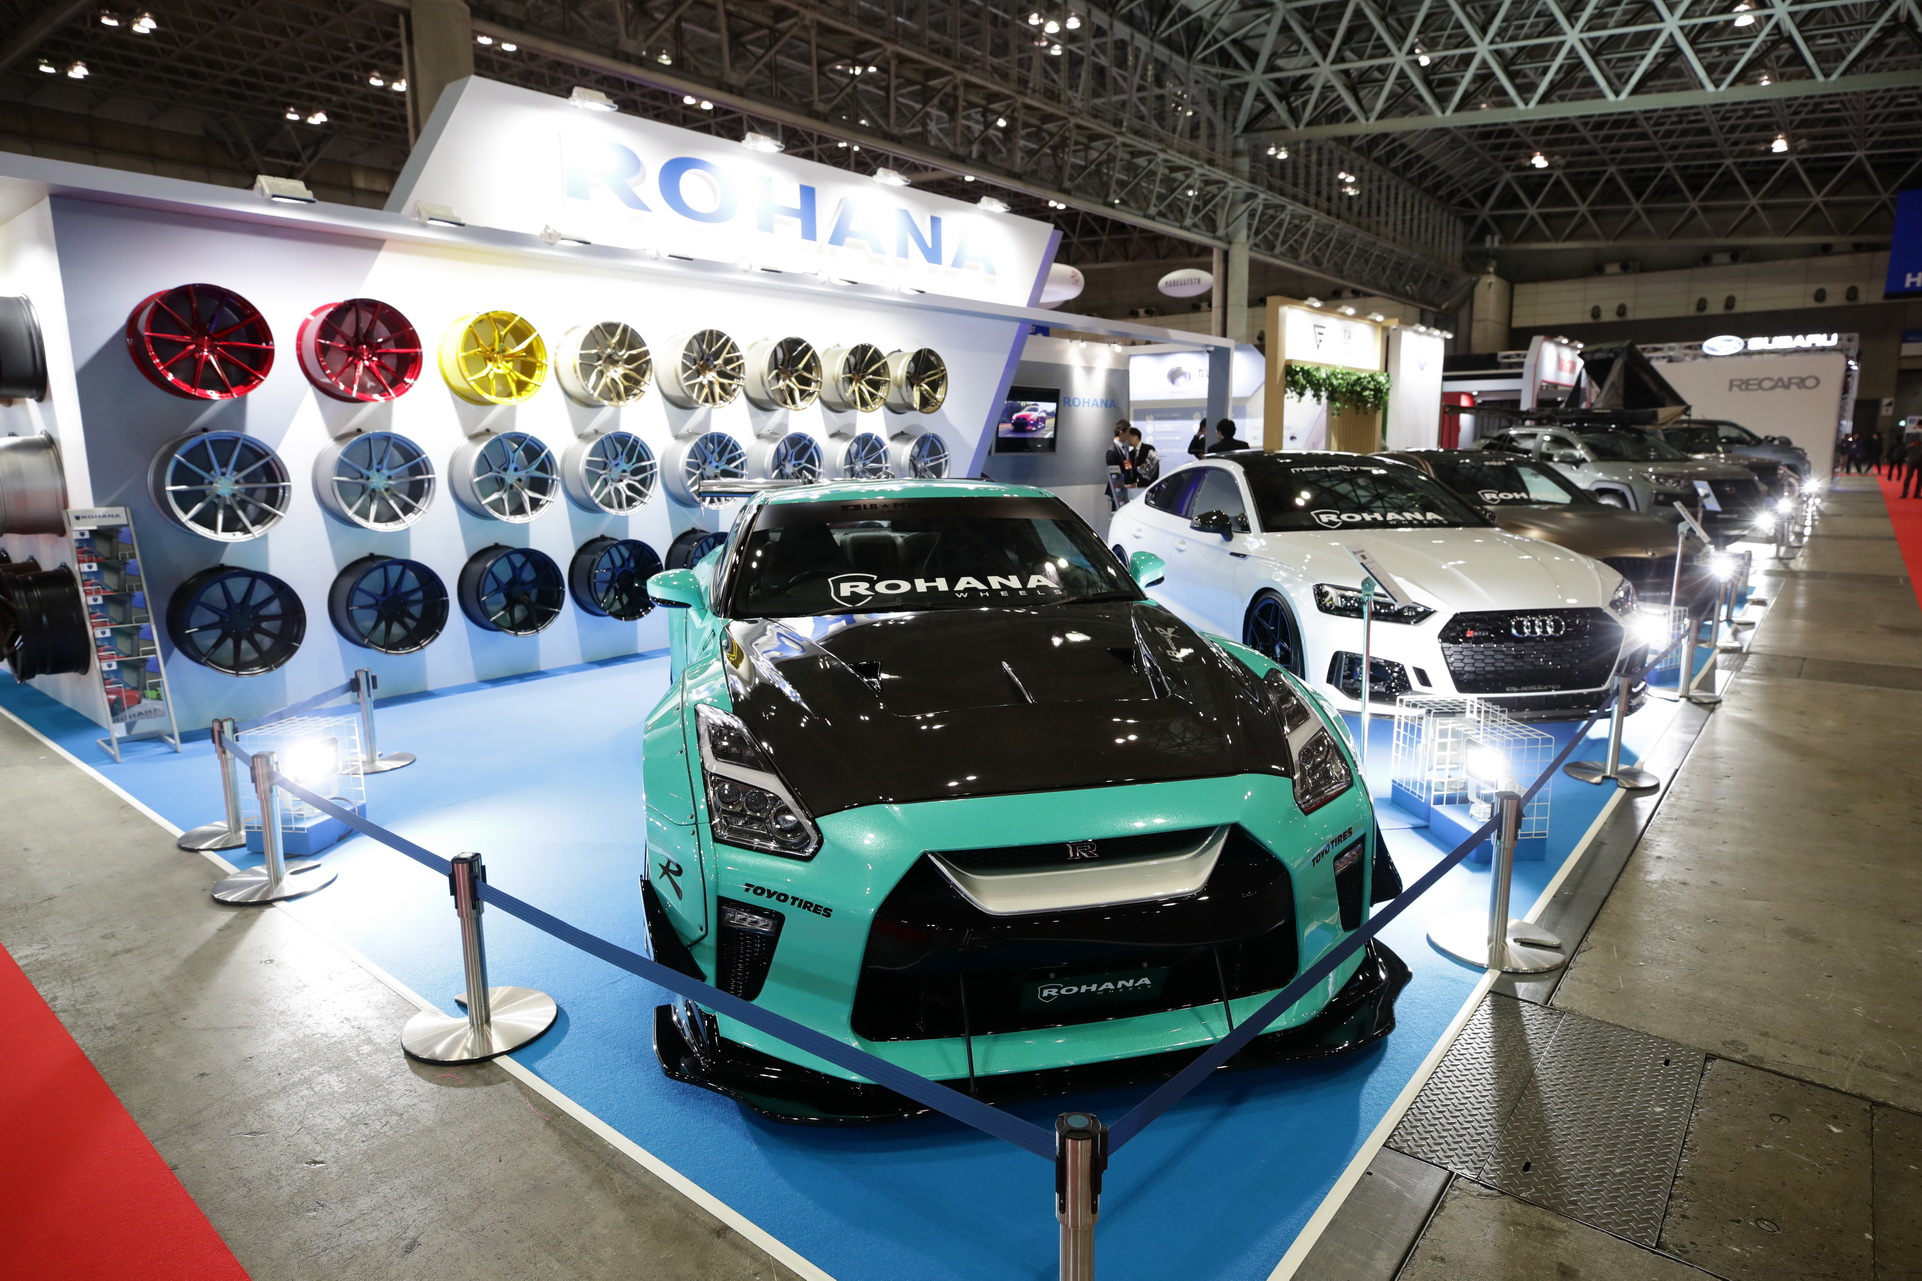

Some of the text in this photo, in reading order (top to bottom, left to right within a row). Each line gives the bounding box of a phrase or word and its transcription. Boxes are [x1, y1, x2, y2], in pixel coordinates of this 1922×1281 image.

[560, 133, 998, 276] ROHANA
[1747, 332, 1839, 351] SUBARU
[1728, 375, 1821, 392] RECARO
[1063, 397, 1117, 409] ROHANA
[1319, 511, 1445, 523] ROHANA
[839, 575, 1061, 598] ROHANA
[955, 590, 1064, 599] WHEELS
[744, 882, 833, 918] TOYO TIRES
[1042, 976, 1152, 998] ROHANA
